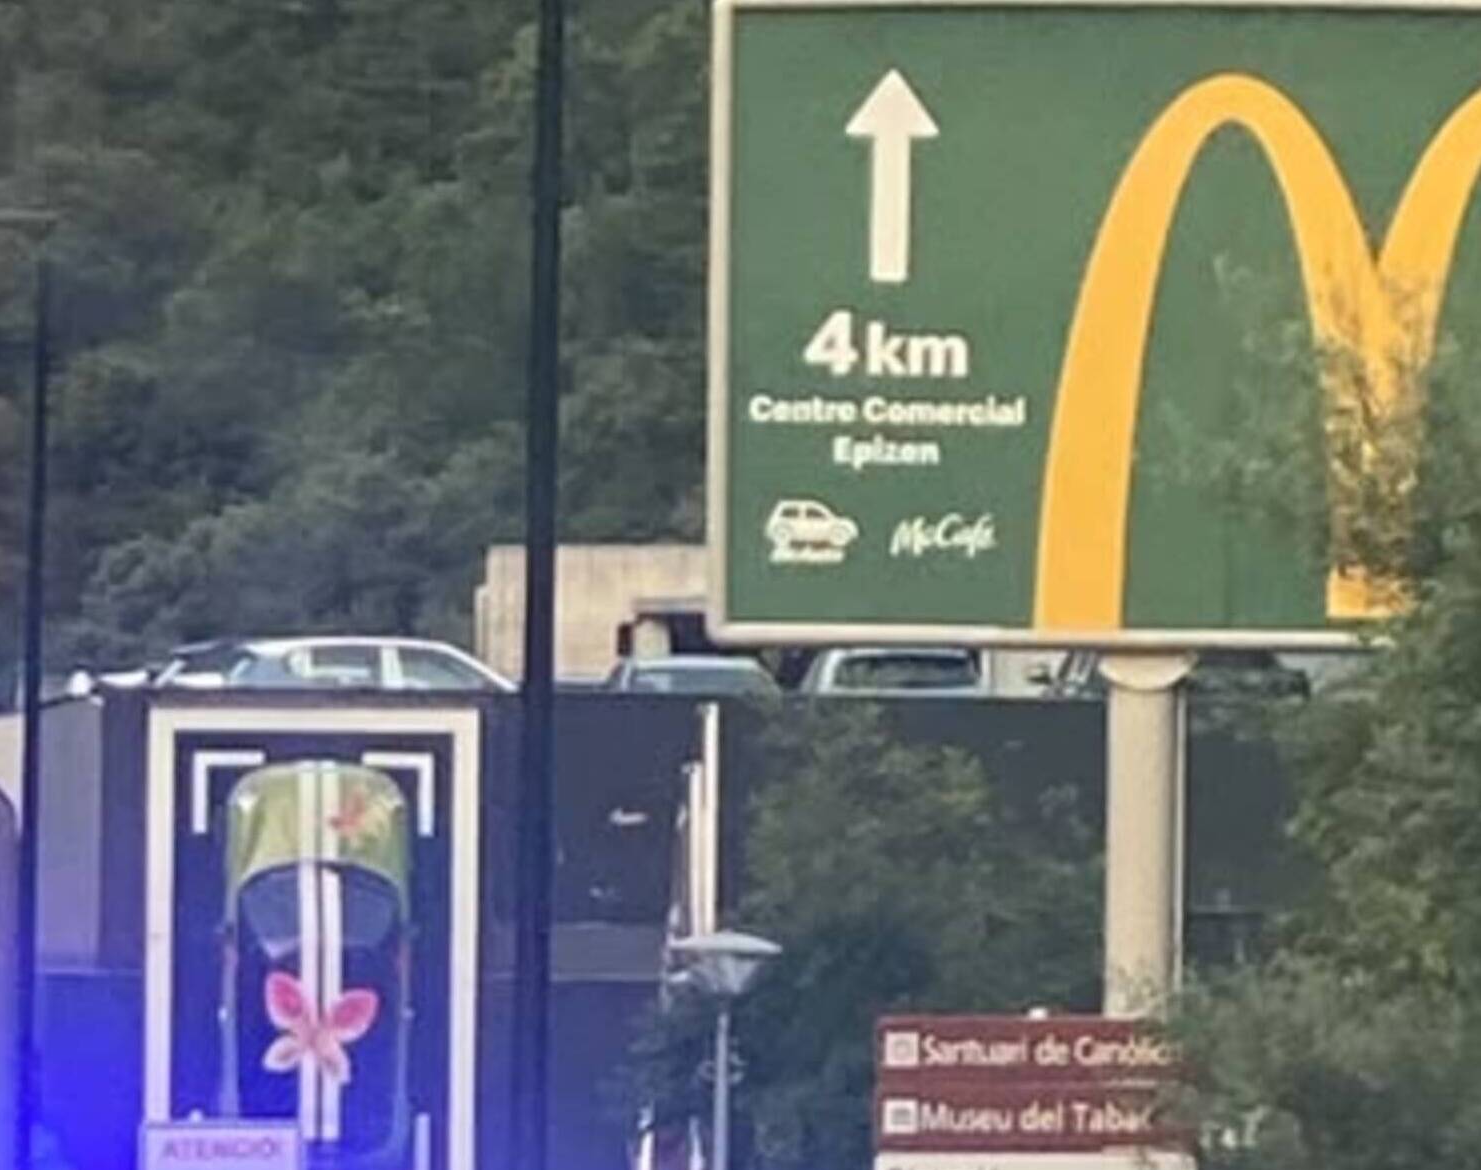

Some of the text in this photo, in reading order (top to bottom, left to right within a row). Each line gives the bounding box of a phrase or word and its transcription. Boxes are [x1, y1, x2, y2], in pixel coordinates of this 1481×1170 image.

[803, 310, 968, 377] 4 km
[749, 395, 1026, 426] Centre Comercial
[833, 434, 939, 469] Epizen
[922, 1033, 1029, 1066] Santuari
[1035, 1033, 1070, 1066] de
[922, 1102, 1013, 1132] Museu
[1019, 1100, 1064, 1132] del
